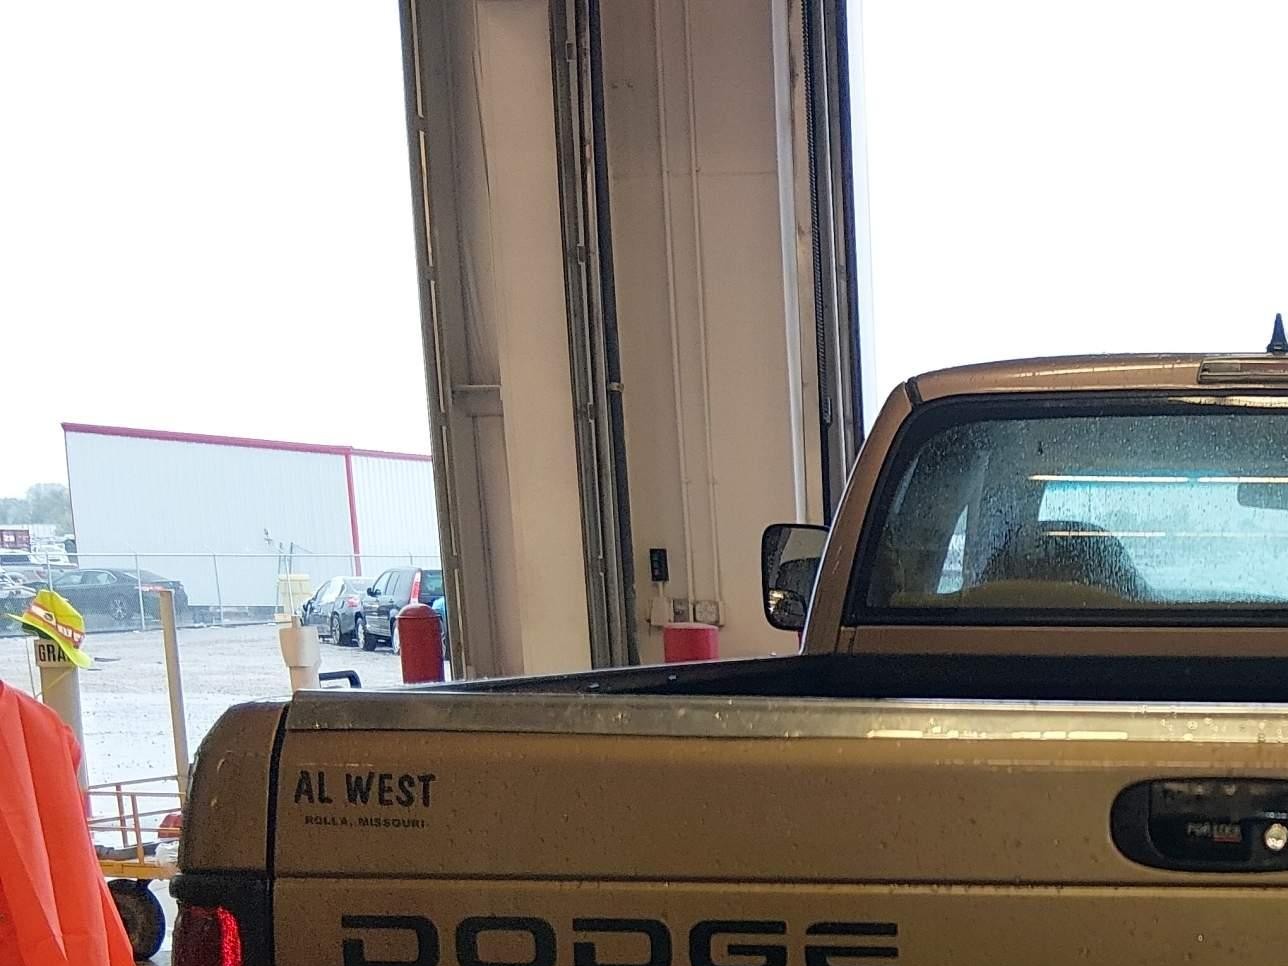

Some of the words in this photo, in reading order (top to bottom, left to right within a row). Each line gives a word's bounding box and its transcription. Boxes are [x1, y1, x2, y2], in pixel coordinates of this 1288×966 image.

[38, 644, 71, 662] GRA
[294, 769, 334, 804] AL
[345, 771, 437, 808] WEST
[357, 816, 427, 829] MISSOURI
